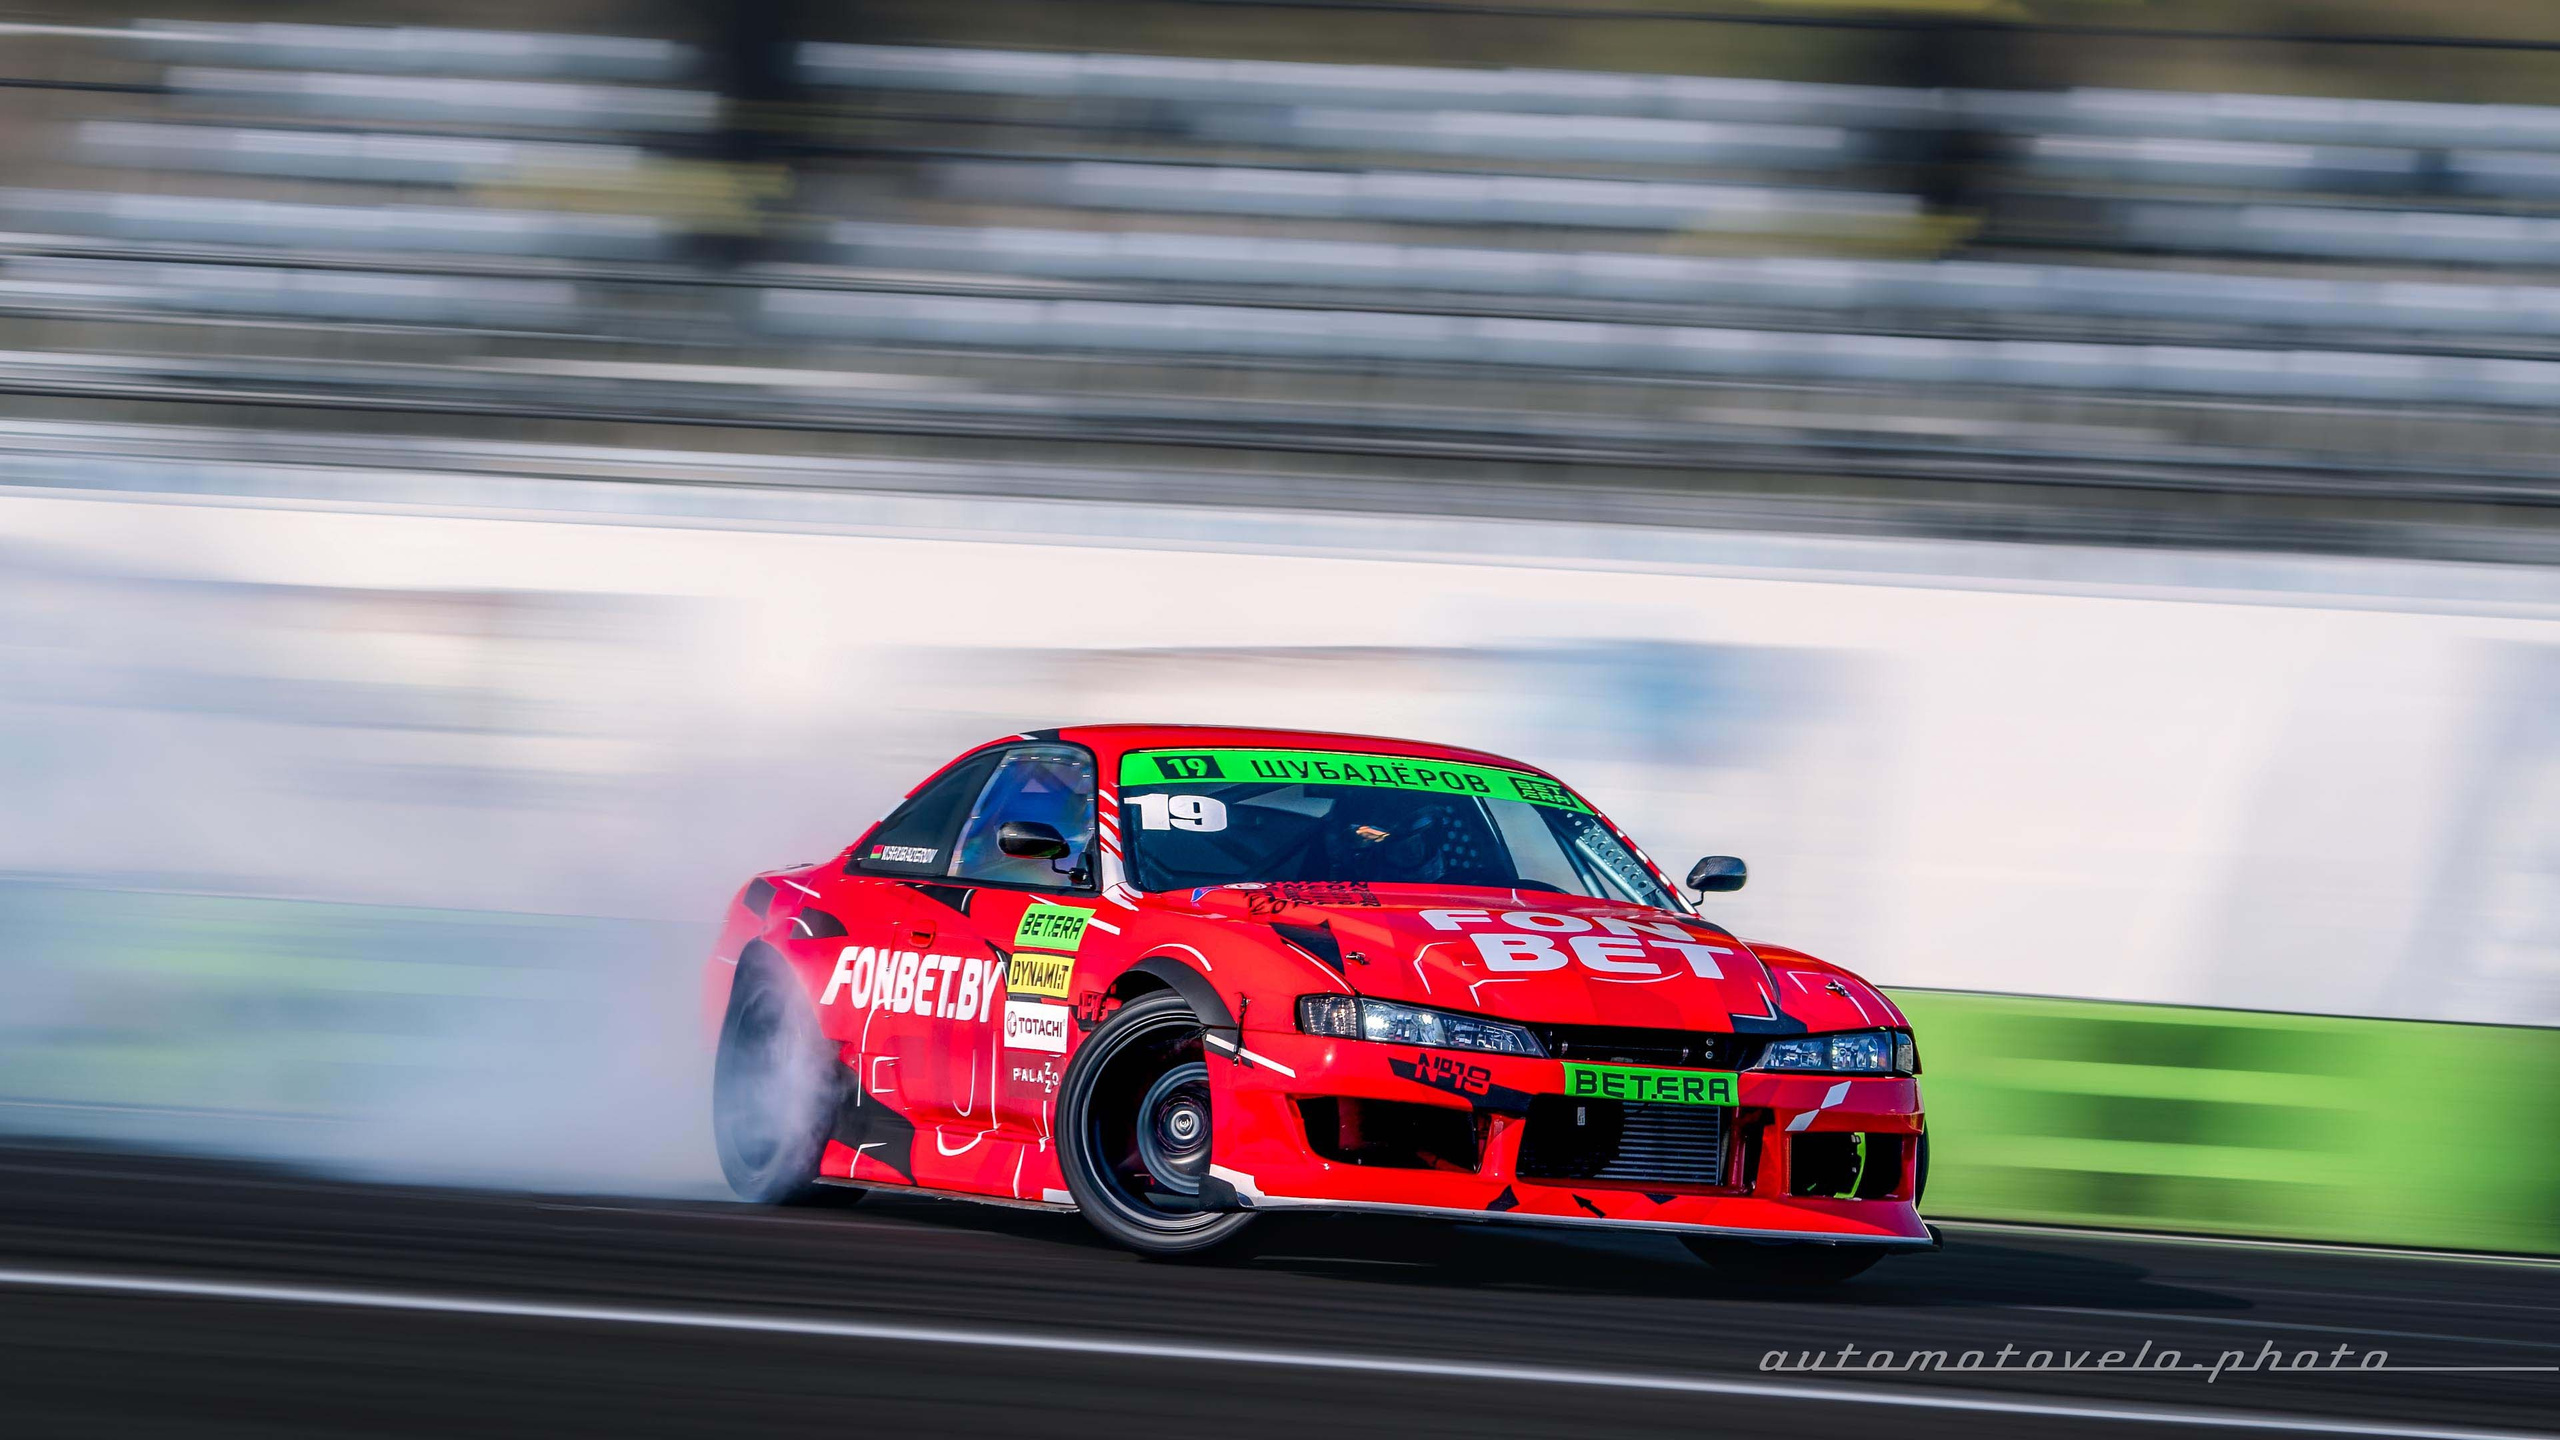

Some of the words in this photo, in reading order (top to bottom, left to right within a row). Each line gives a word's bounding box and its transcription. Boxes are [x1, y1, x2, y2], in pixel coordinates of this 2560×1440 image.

[1166, 758, 1210, 778] 19
[1250, 759, 1491, 793] ШУБАДЁРОВ
[1124, 793, 1228, 832] 19
[1419, 909, 1696, 942] FON
[1469, 933, 1734, 980] BET
[819, 946, 1007, 1023] FONBET.BY
[1018, 1016, 1063, 1038] TOTACHI
